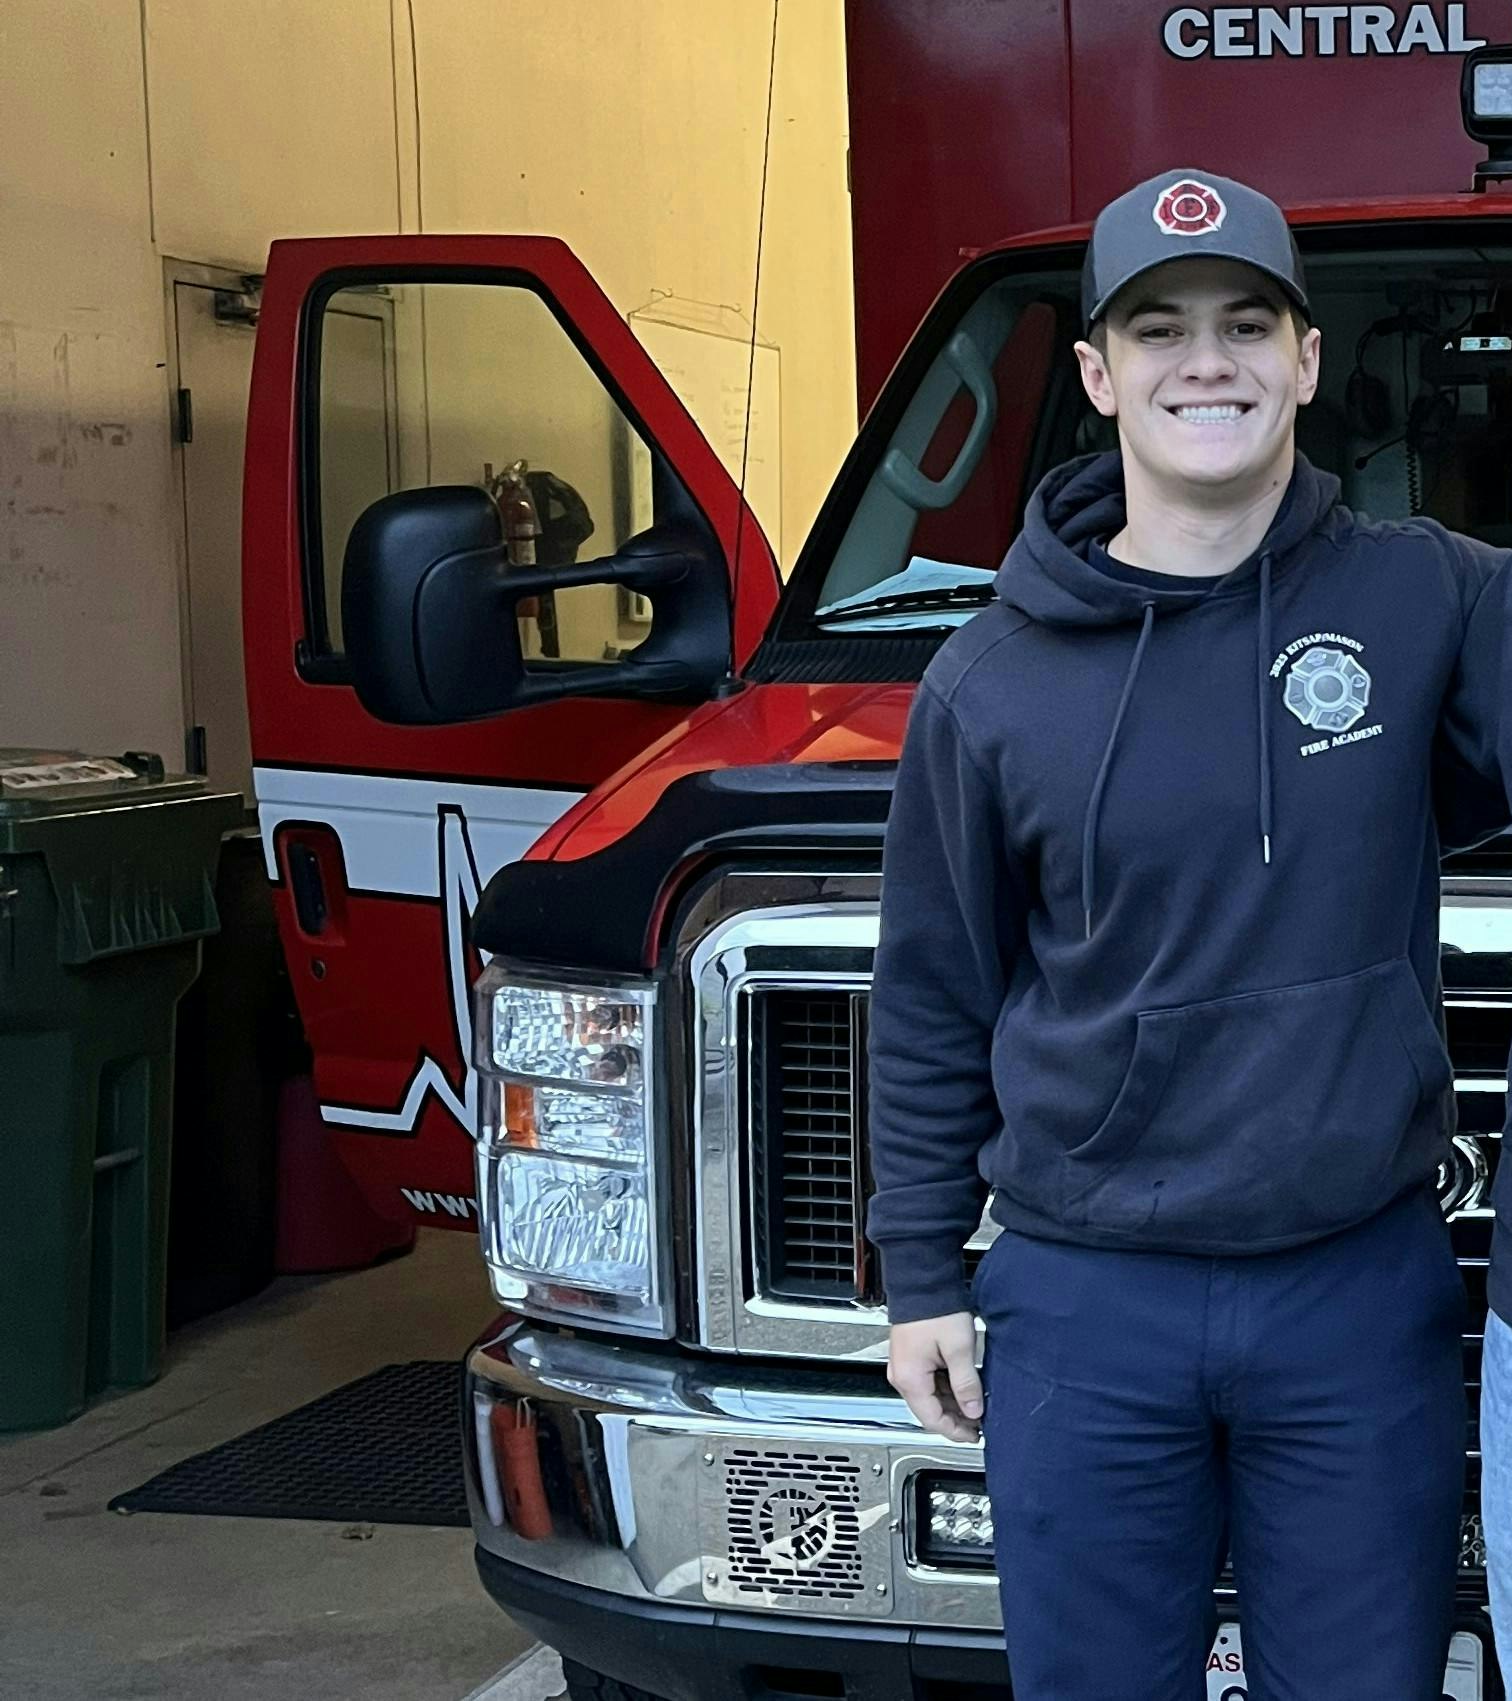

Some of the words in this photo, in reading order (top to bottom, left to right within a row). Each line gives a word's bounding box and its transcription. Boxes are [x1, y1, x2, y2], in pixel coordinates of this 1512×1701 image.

[1163, 3, 1487, 58] CENTRAL
[1300, 739, 1330, 757] FIRE
[1332, 724, 1383, 746] ACADEMY
